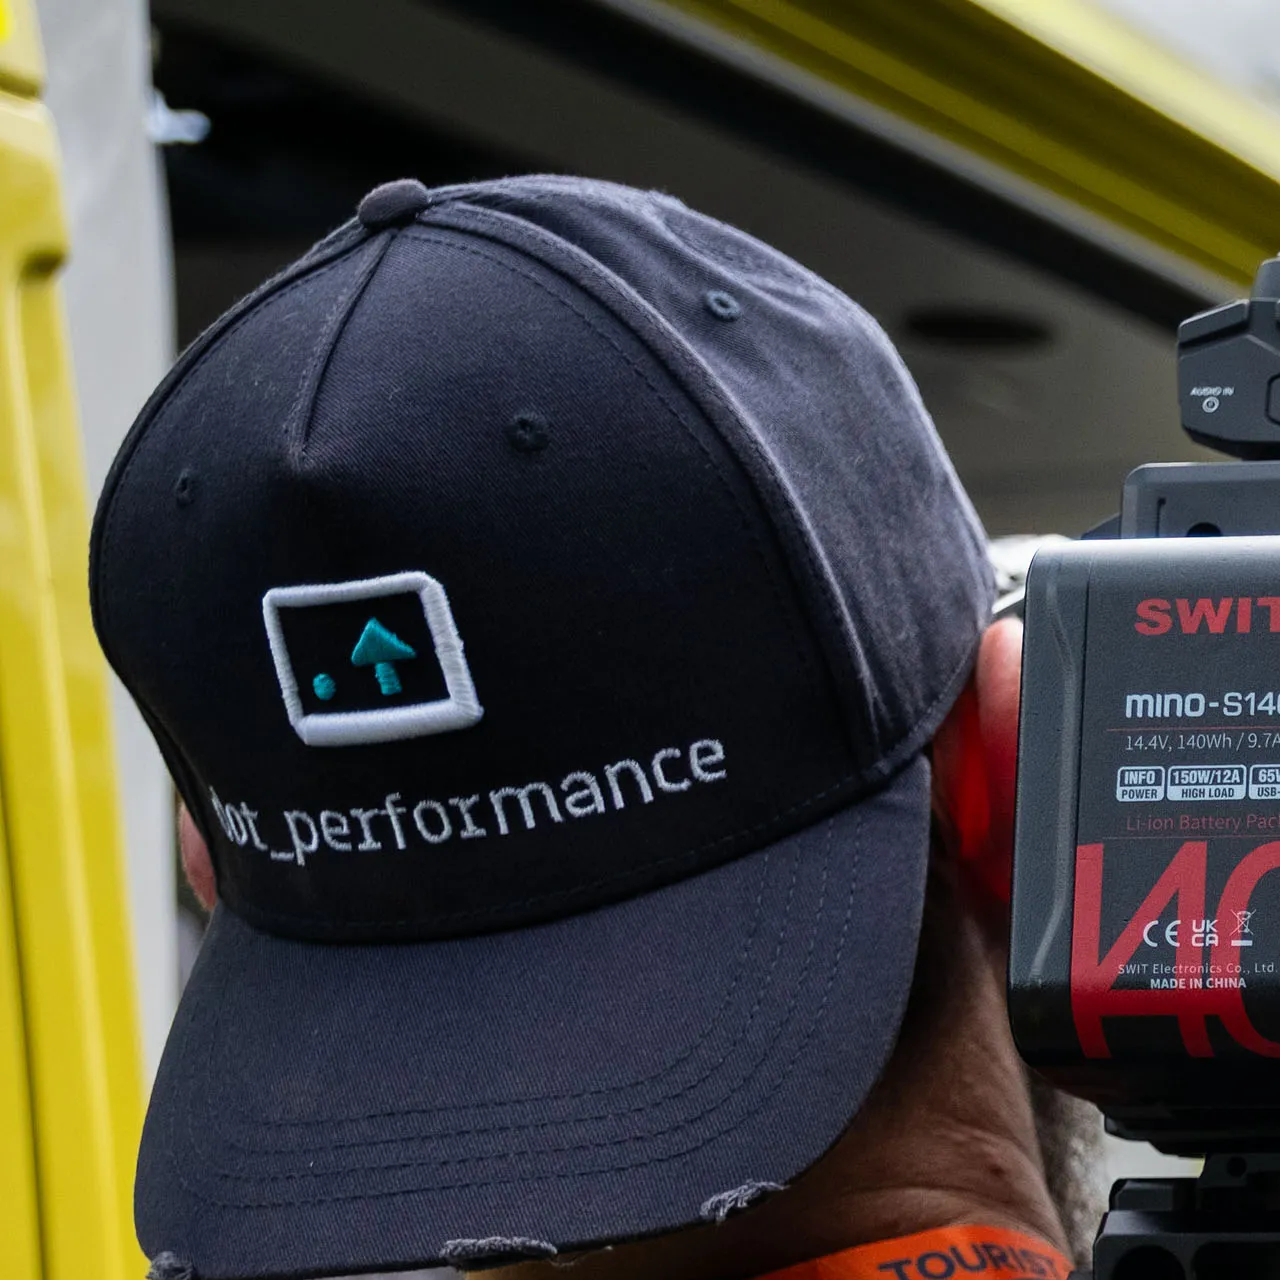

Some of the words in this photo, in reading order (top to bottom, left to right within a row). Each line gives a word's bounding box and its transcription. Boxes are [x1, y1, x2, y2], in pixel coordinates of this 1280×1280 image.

[1190, 386, 1222, 397] AUDIO
[1223, 386, 1234, 396] IN
[1125, 734, 1173, 753] 14.4V,
[1177, 732, 1232, 750] 140Wh
[1123, 770, 1155, 785] INFO
[1172, 769, 1240, 785] 150W/12A
[1121, 788, 1158, 800] POWER
[1181, 787, 1205, 799] HIGH
[1207, 787, 1235, 799] LOAD
[1126, 815, 1176, 831] Li-ion
[1180, 814, 1241, 833] Battery
[1142, 920, 1182, 947] CE
[1192, 920, 1219, 933] UK
[1191, 934, 1219, 947] CA
[1118, 963, 1149, 975] SWIT
[1152, 962, 1222, 975] Electronics
[1226, 962, 1250, 976] Co.,
[1255, 961, 1278, 974] Ltd.
[1150, 978, 1186, 990] MADE
[1189, 978, 1203, 989] IN
[1206, 977, 1247, 989] CHINA
